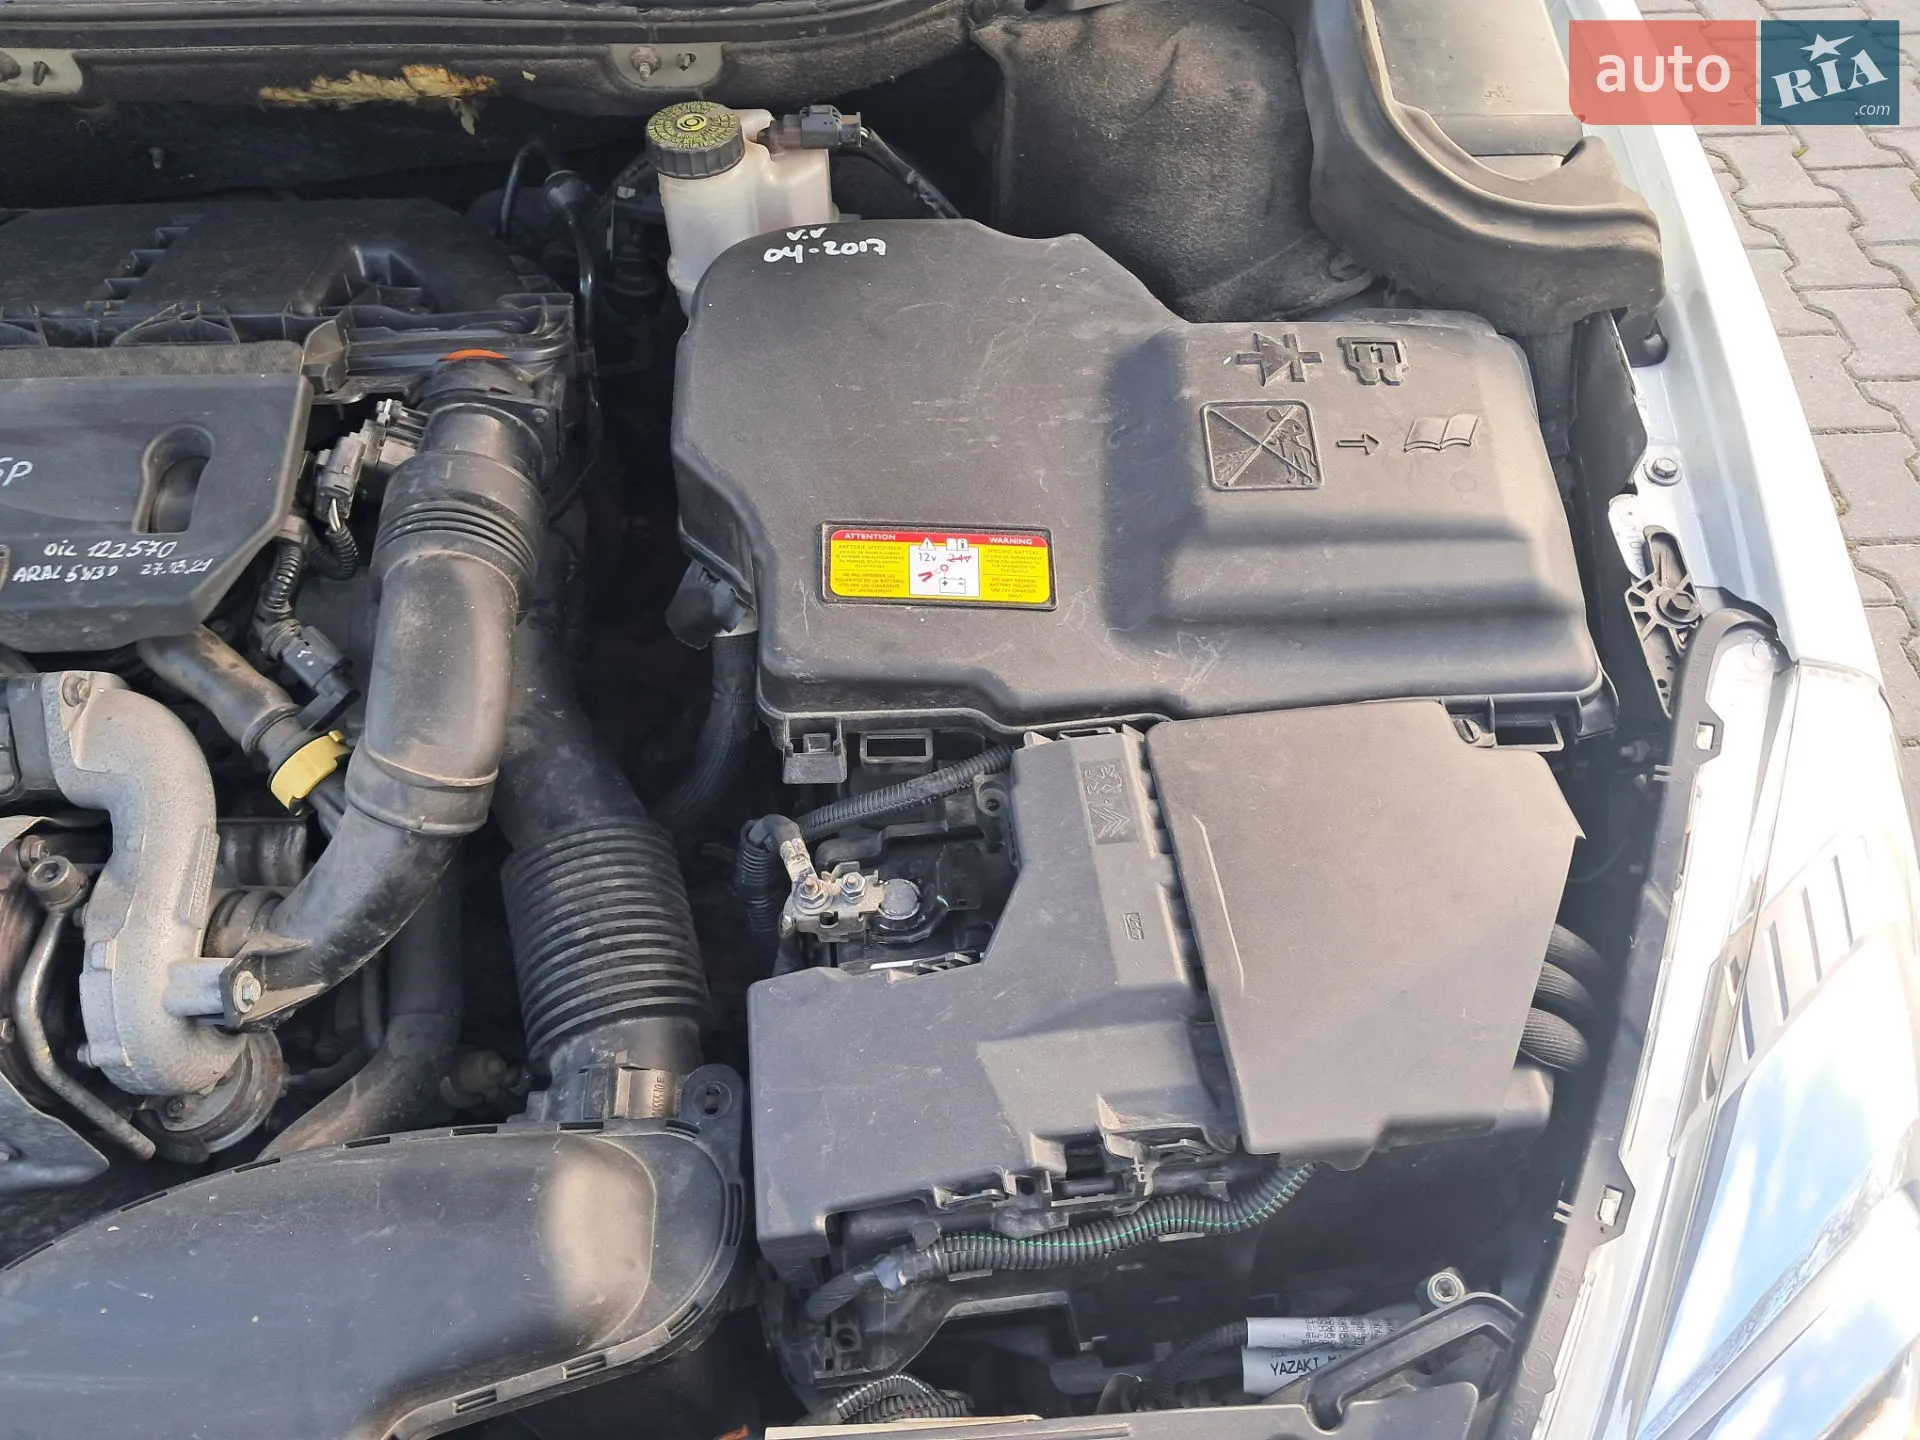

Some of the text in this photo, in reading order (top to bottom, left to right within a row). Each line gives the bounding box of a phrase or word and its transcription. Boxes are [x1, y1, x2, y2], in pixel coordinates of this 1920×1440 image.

[763, 238, 886, 263] 04-2017
[844, 532, 896, 541] ATTENTION
[989, 536, 1033, 546] WARNING
[87, 540, 177, 559] 122570
[12, 564, 62, 582] ARAL
[1270, 1357, 1319, 1376] YAZAKI
